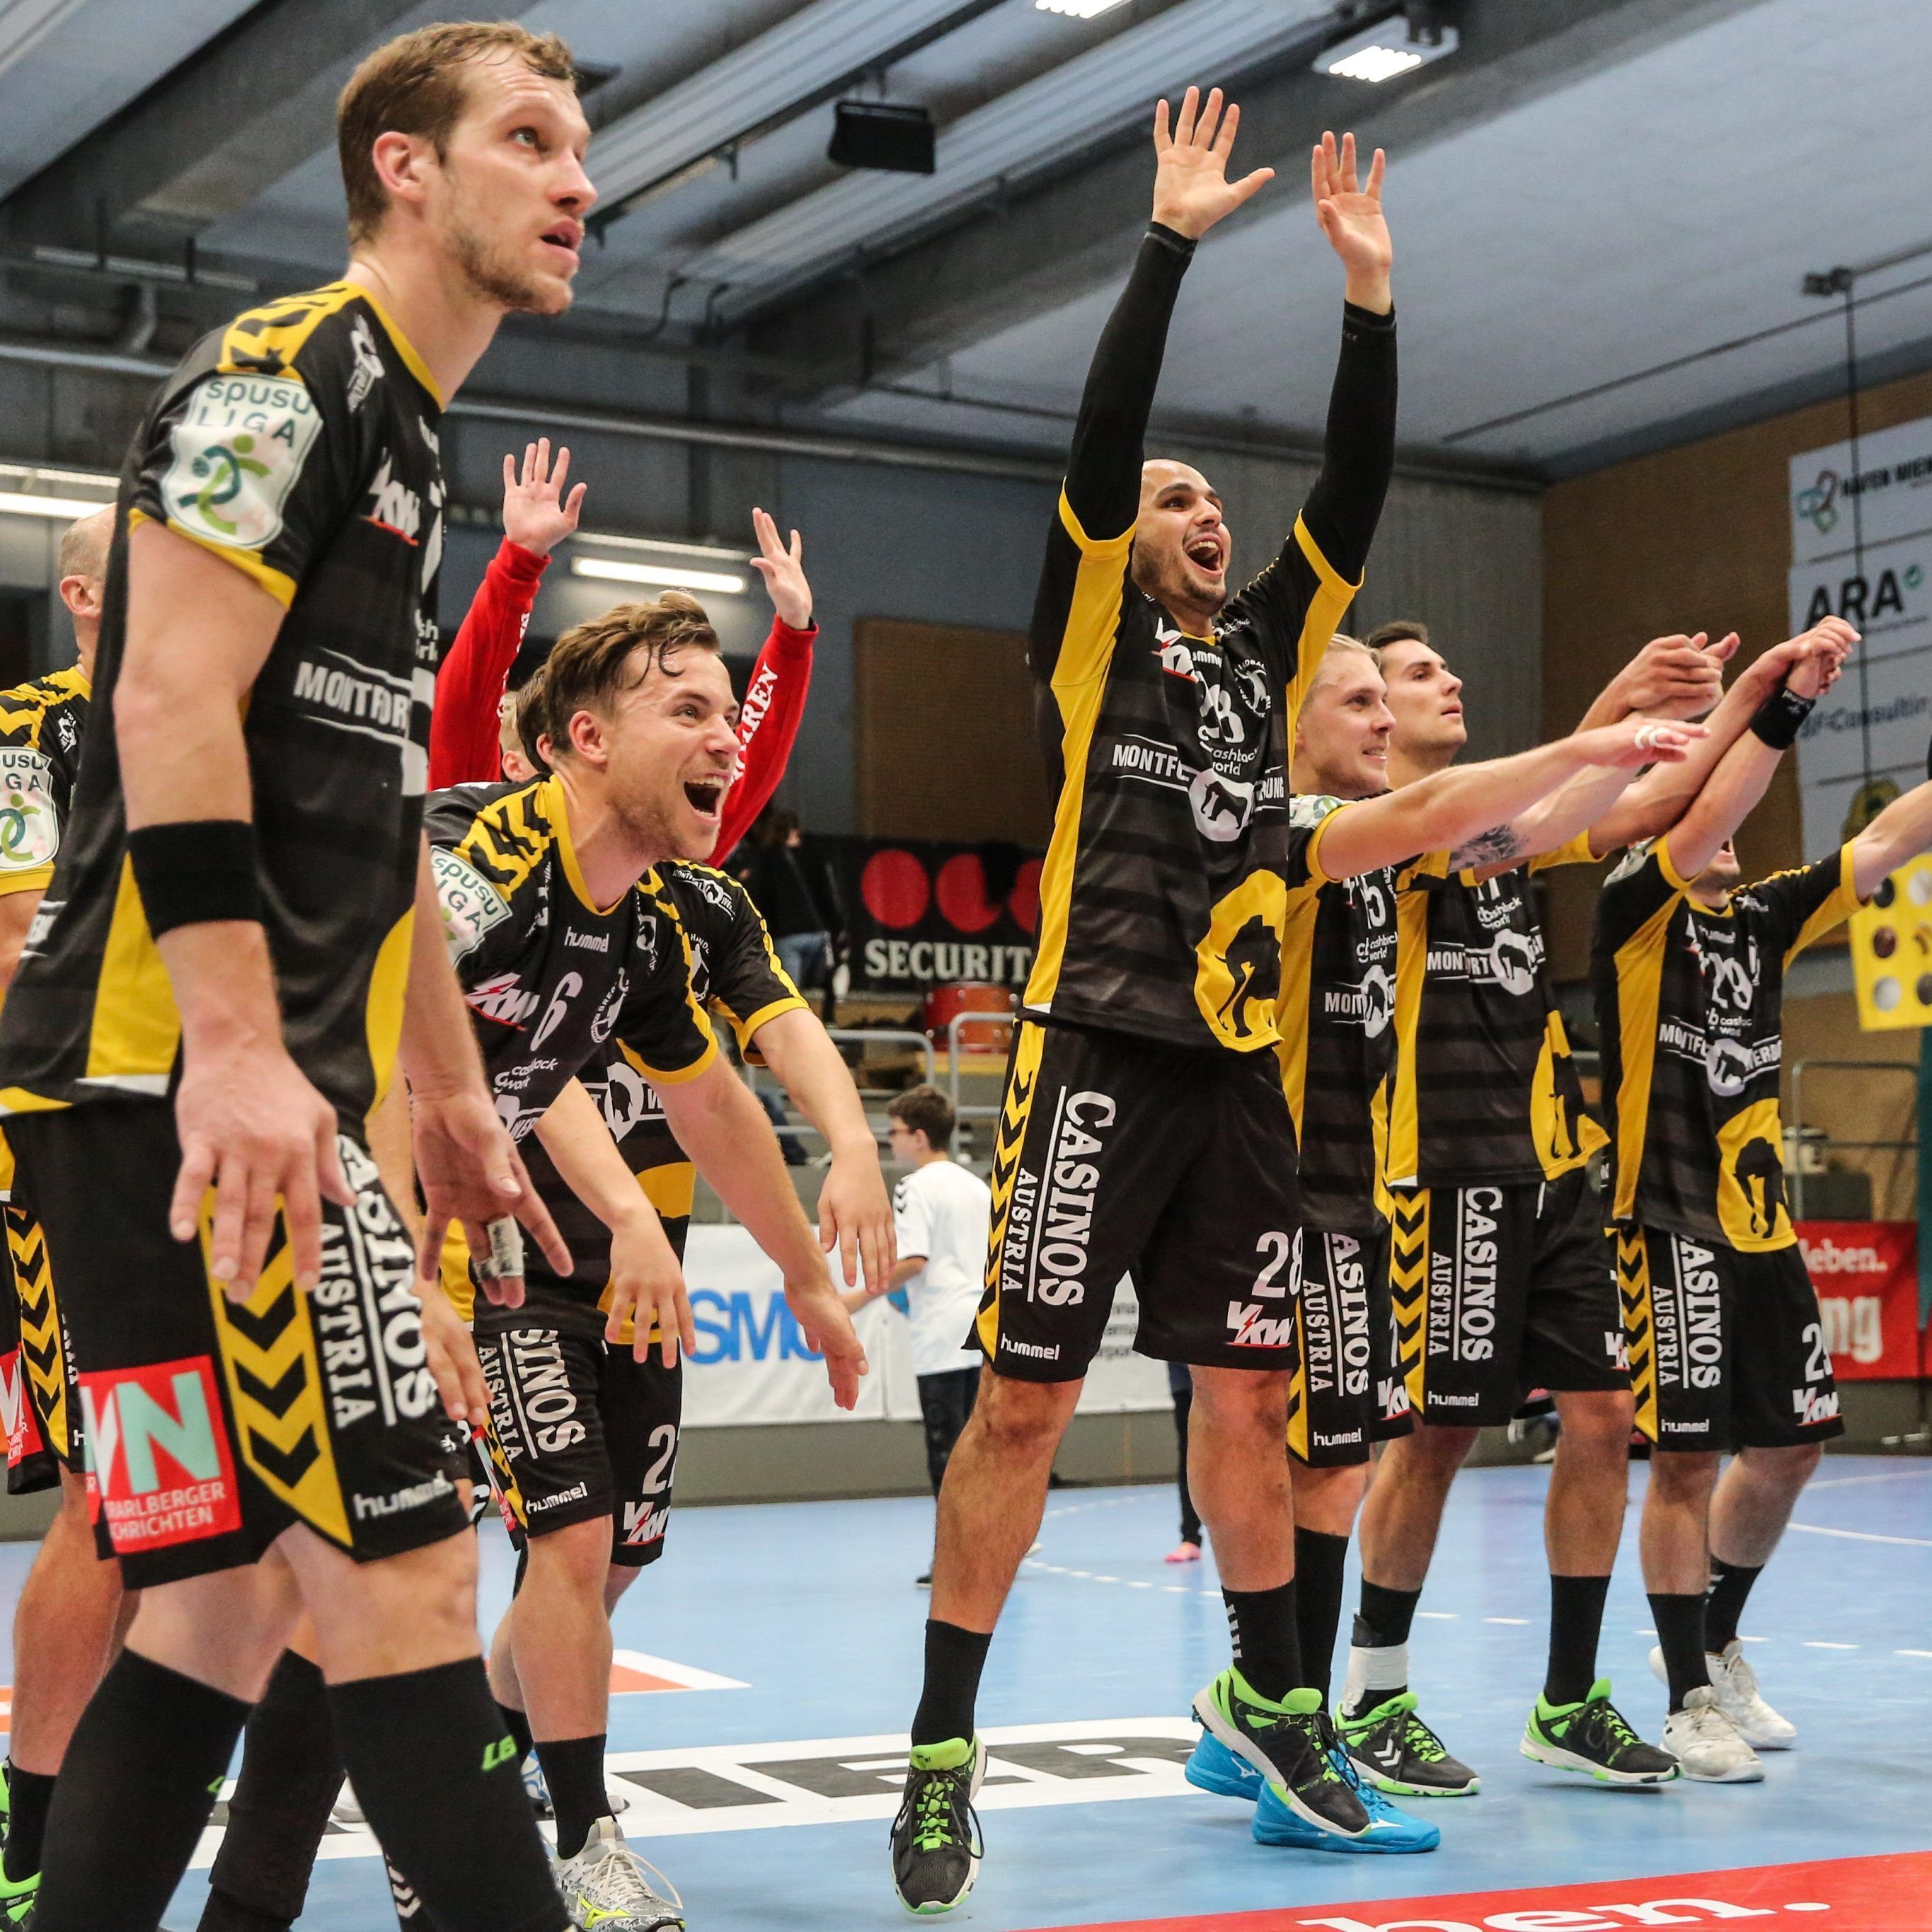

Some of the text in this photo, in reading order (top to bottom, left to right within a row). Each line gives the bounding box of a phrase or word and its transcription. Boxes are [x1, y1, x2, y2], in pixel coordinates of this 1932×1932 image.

[197, 406, 297, 448] LIGA
[206, 380, 311, 415] spusu
[1802, 568, 1904, 632] ARA
[293, 660, 412, 732] MONTFOR
[432, 857, 499, 916] spusu
[437, 878, 481, 932] IGA
[564, 926, 609, 953] hummel
[864, 938, 1033, 984] SECURIT
[530, 971, 583, 1052] 6
[1001, 1168, 1039, 1292] AUSTRIA
[1037, 1091, 1117, 1306] CASINOS
[1251, 1226, 1304, 1299] 28
[1461, 1185, 1504, 1362] CASINOS
[1302, 1280, 1334, 1393] AUSTRIA
[1331, 1233, 1371, 1396] ASINOS
[1428, 1252, 1452, 1356] AUSTRIA
[1652, 1285, 1680, 1386] AUSTRIA
[1680, 1238, 1723, 1388] ASINOS
[1000, 1333, 1060, 1361] hummel
[478, 1346, 524, 1463] AUSTRIA
[510, 1328, 586, 1453] SINOS
[1427, 1391, 1479, 1407] hummel
[1313, 1427, 1362, 1447] hummel
[526, 1481, 588, 1514] hummel
